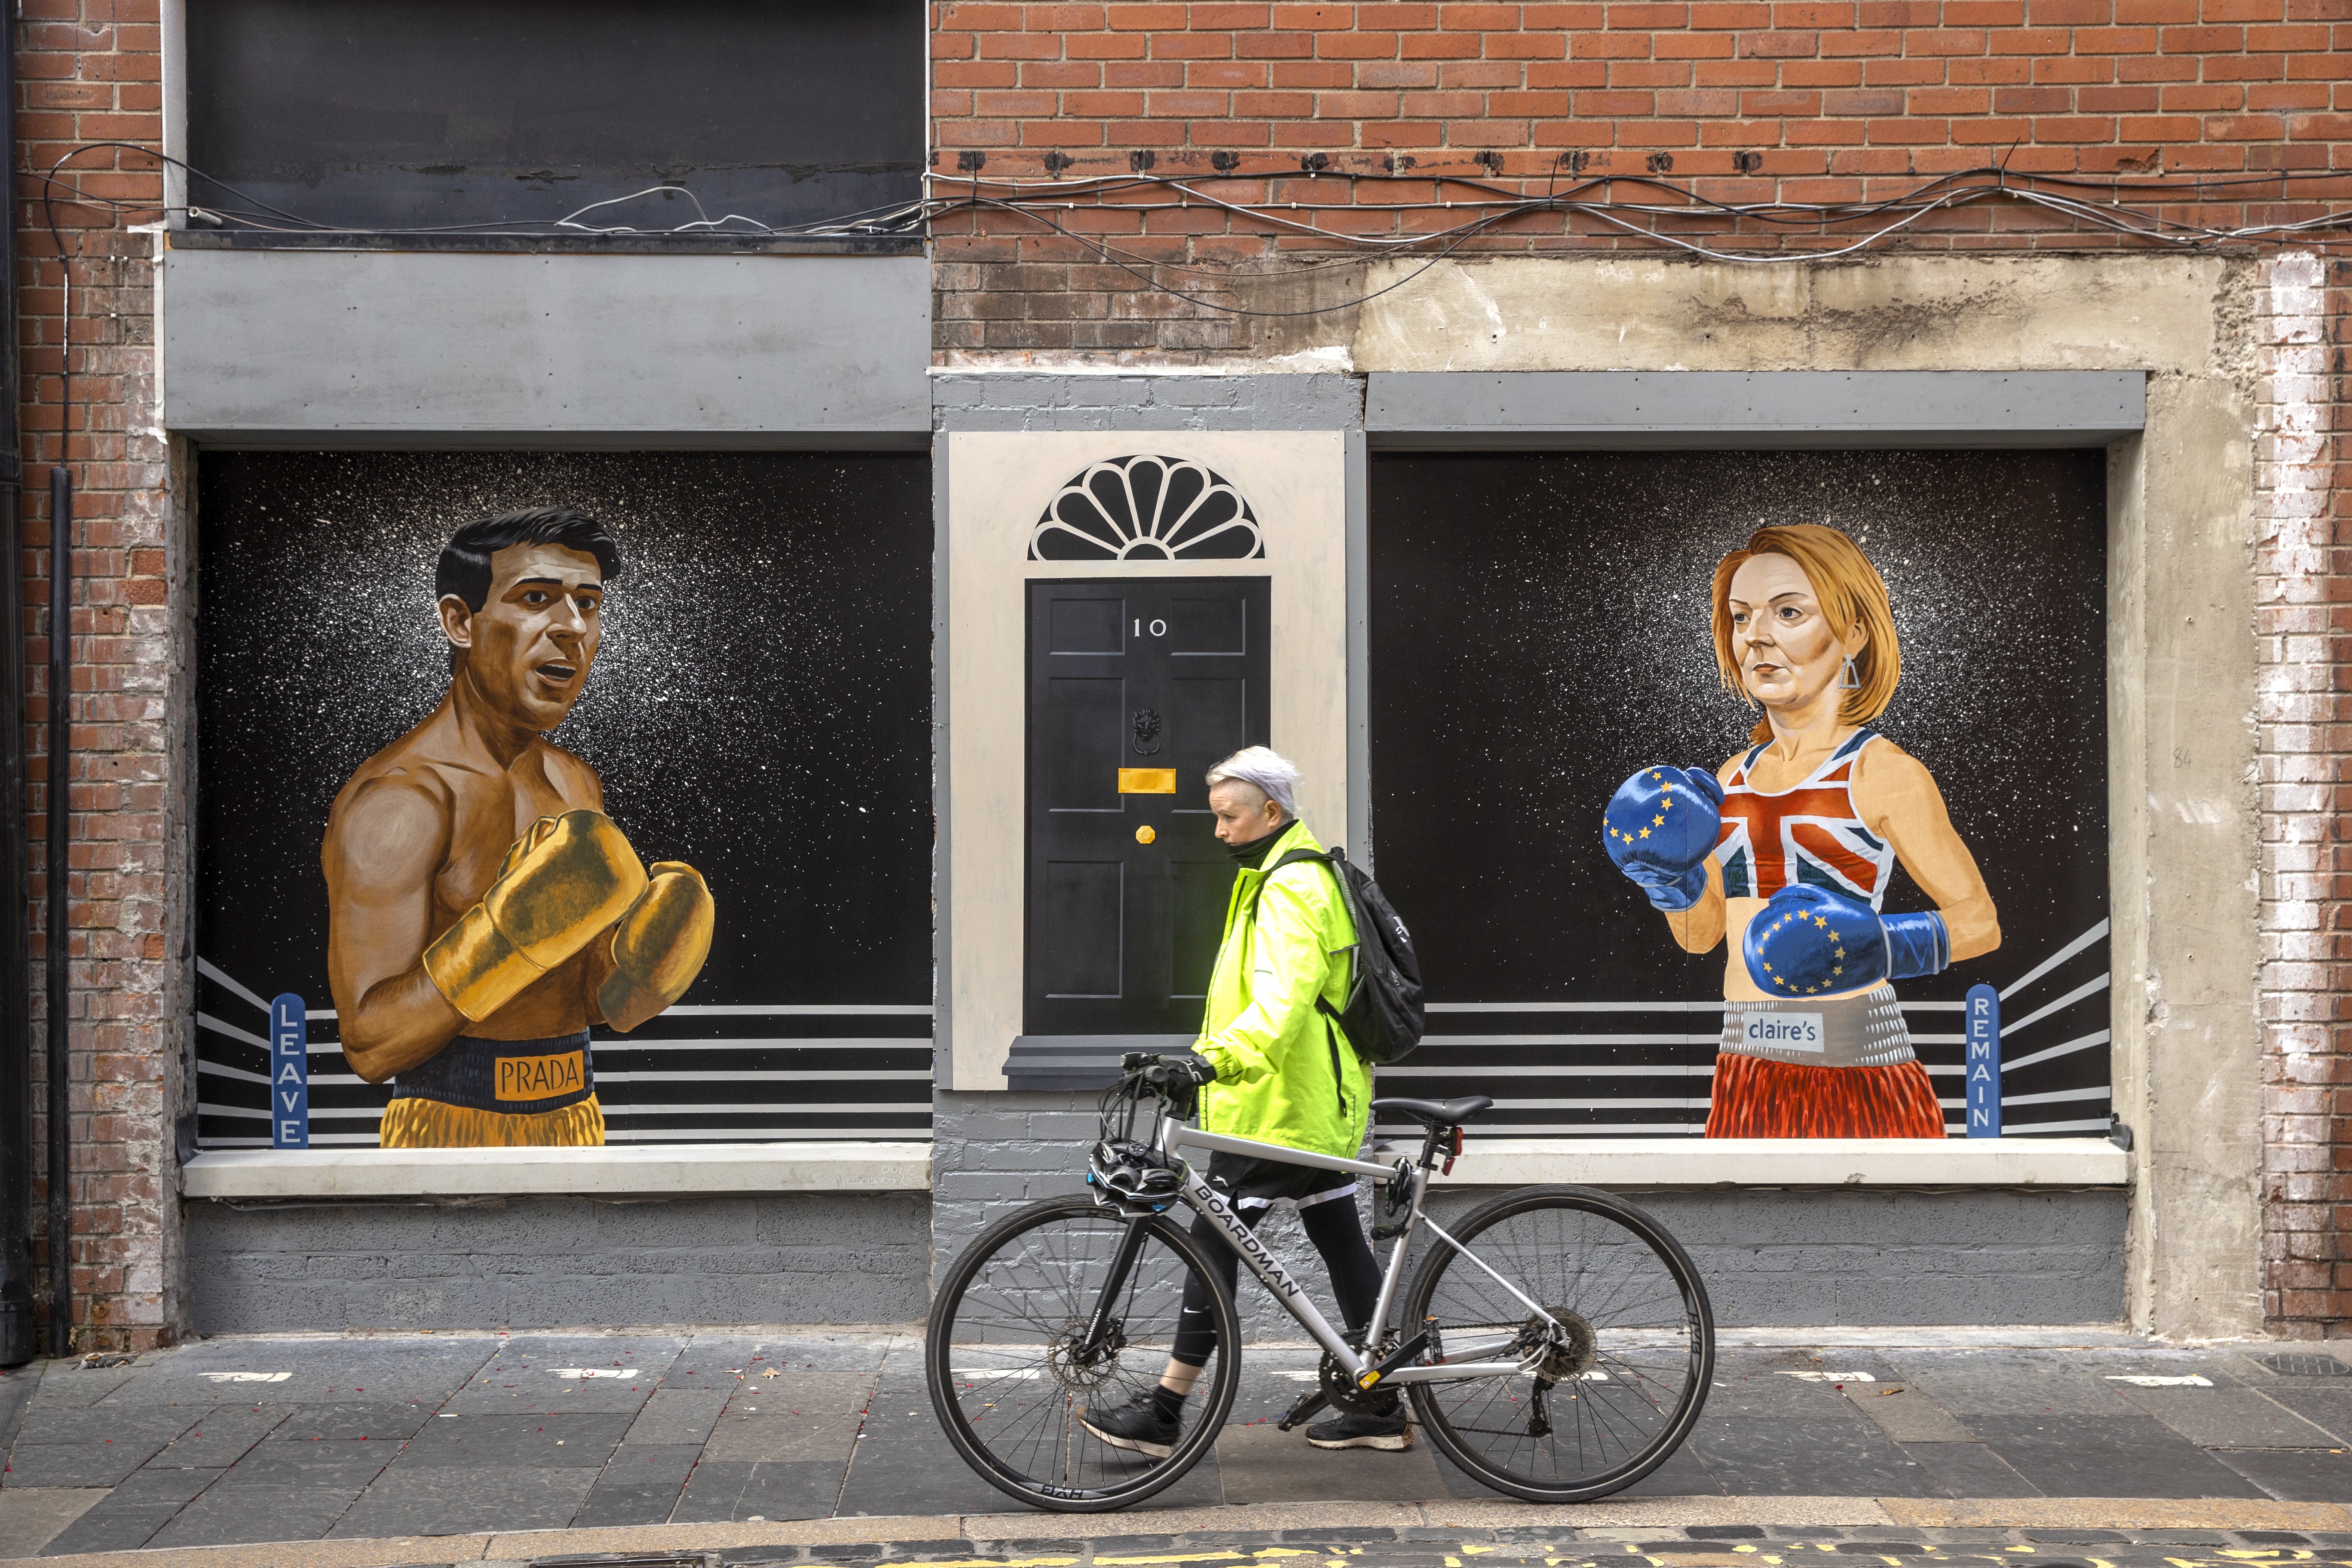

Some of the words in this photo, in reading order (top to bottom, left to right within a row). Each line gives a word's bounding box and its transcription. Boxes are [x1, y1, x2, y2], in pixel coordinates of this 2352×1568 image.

[1134, 618, 1167, 637] 10
[2173, 746, 2193, 769] 84
[1748, 1019, 1816, 1042] claire's
[276, 1004, 302, 1144] LEAVE
[500, 1057, 579, 1093] PRADA
[1971, 998, 1992, 1127] REMAIN
[1194, 1185, 1300, 1298] BOARDMAN
